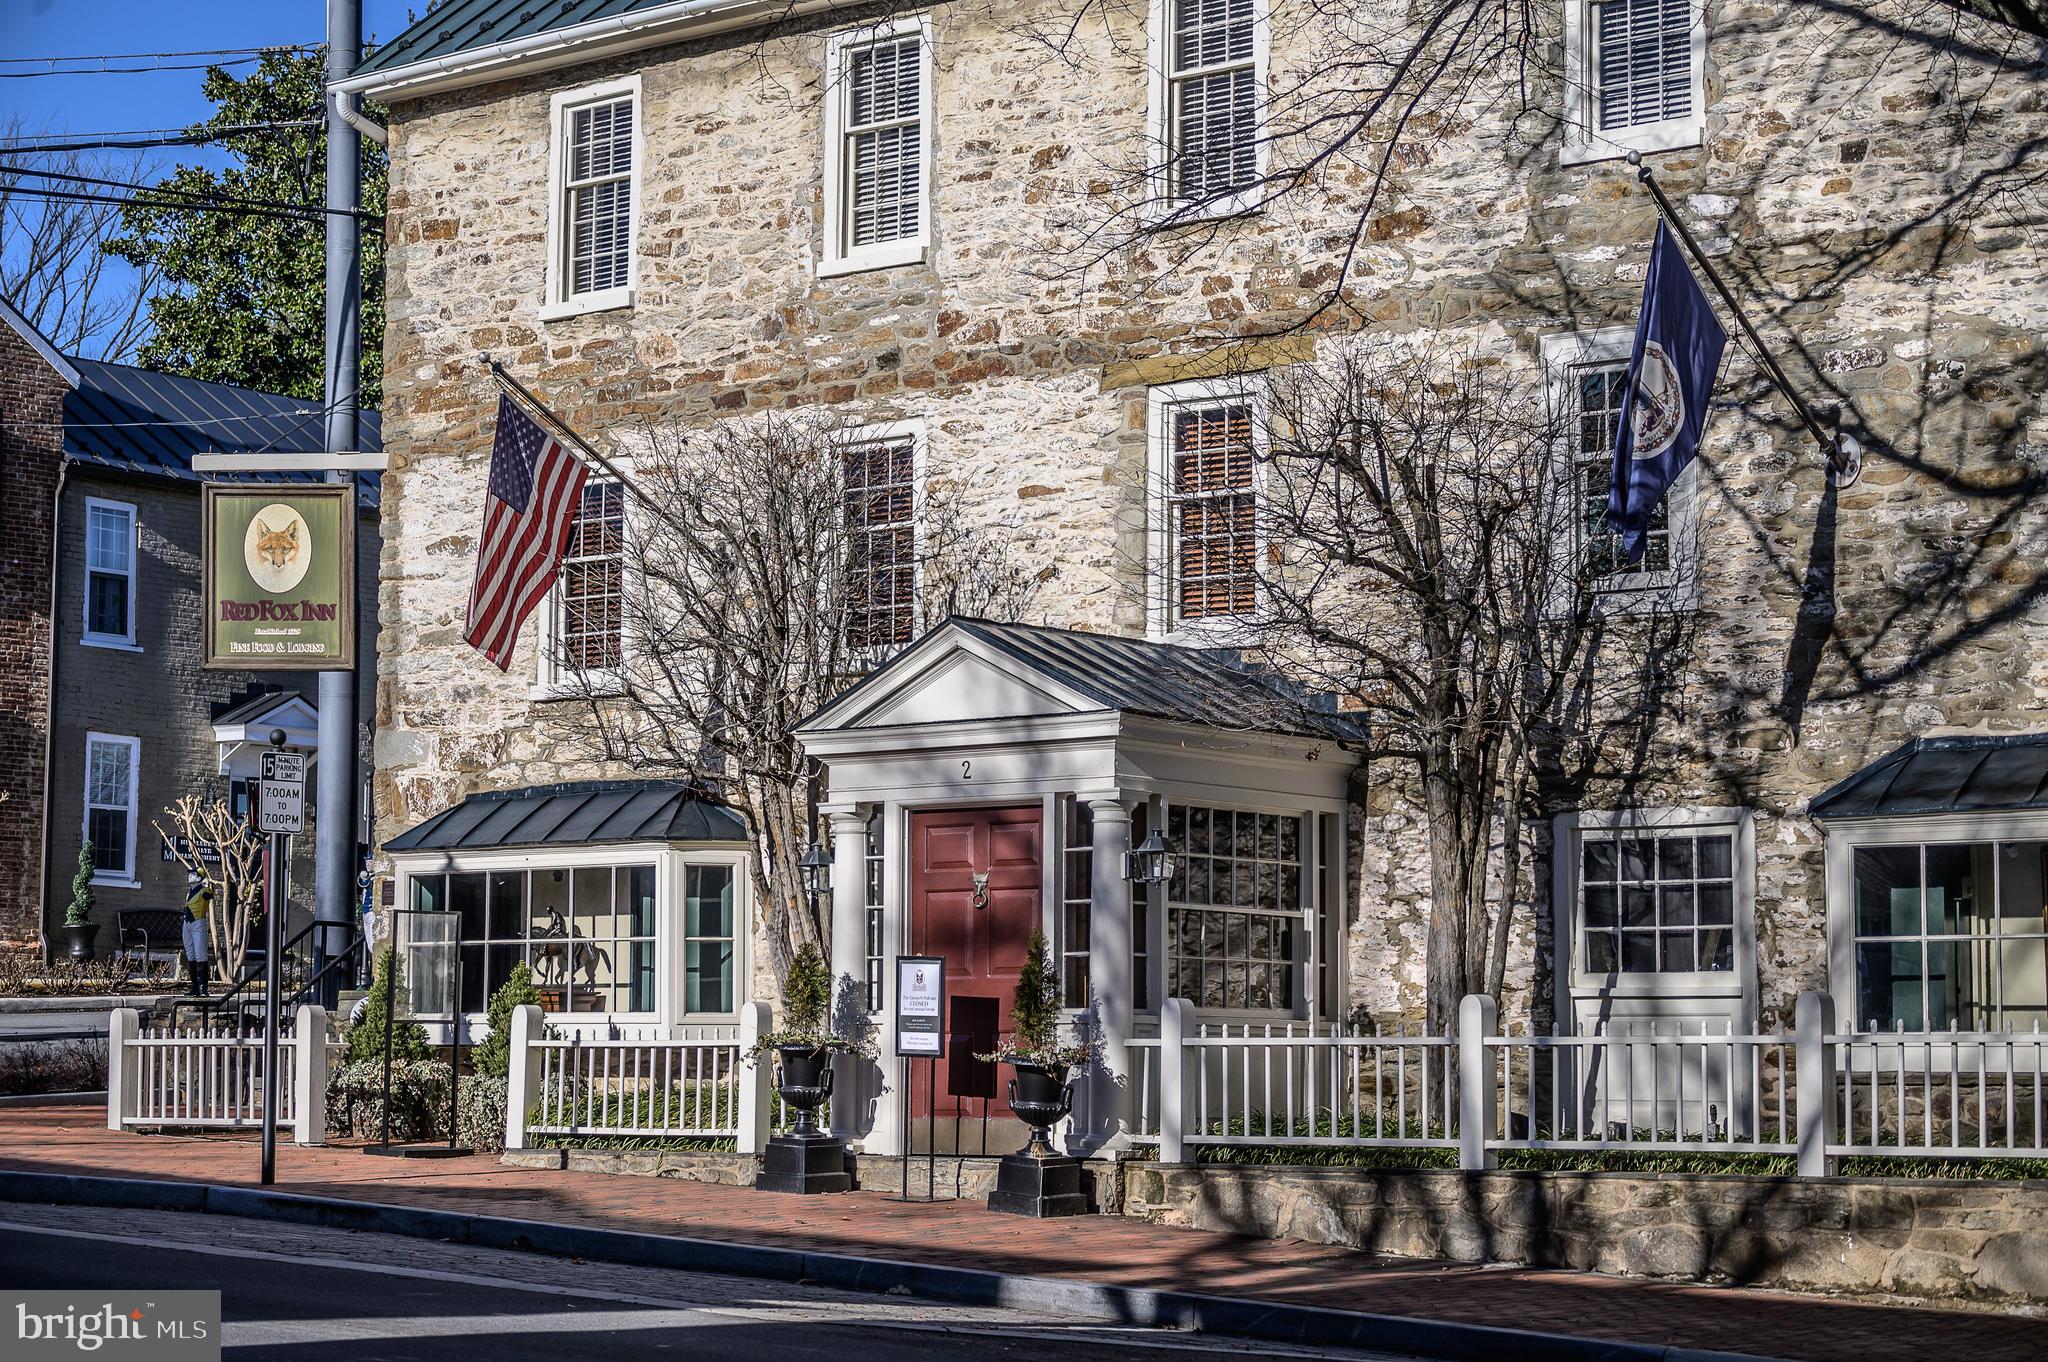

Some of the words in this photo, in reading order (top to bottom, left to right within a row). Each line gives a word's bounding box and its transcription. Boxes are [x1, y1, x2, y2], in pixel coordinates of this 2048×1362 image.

[220, 600, 260, 621] RED
[258, 600, 300, 621] FOX
[300, 600, 337, 621] INN
[230, 642, 250, 653] FINE
[251, 642, 275, 653] FOOD
[276, 642, 286, 653] &
[287, 642, 325, 653] LODGING
[263, 757, 275, 777] 15
[278, 757, 300, 765] MINUTE
[276, 764, 302, 773] PARKING
[962, 760, 972, 779] 2
[265, 787, 300, 799] 7:00AM
[277, 802, 287, 810] TO
[265, 813, 299, 825] 7:00PM
